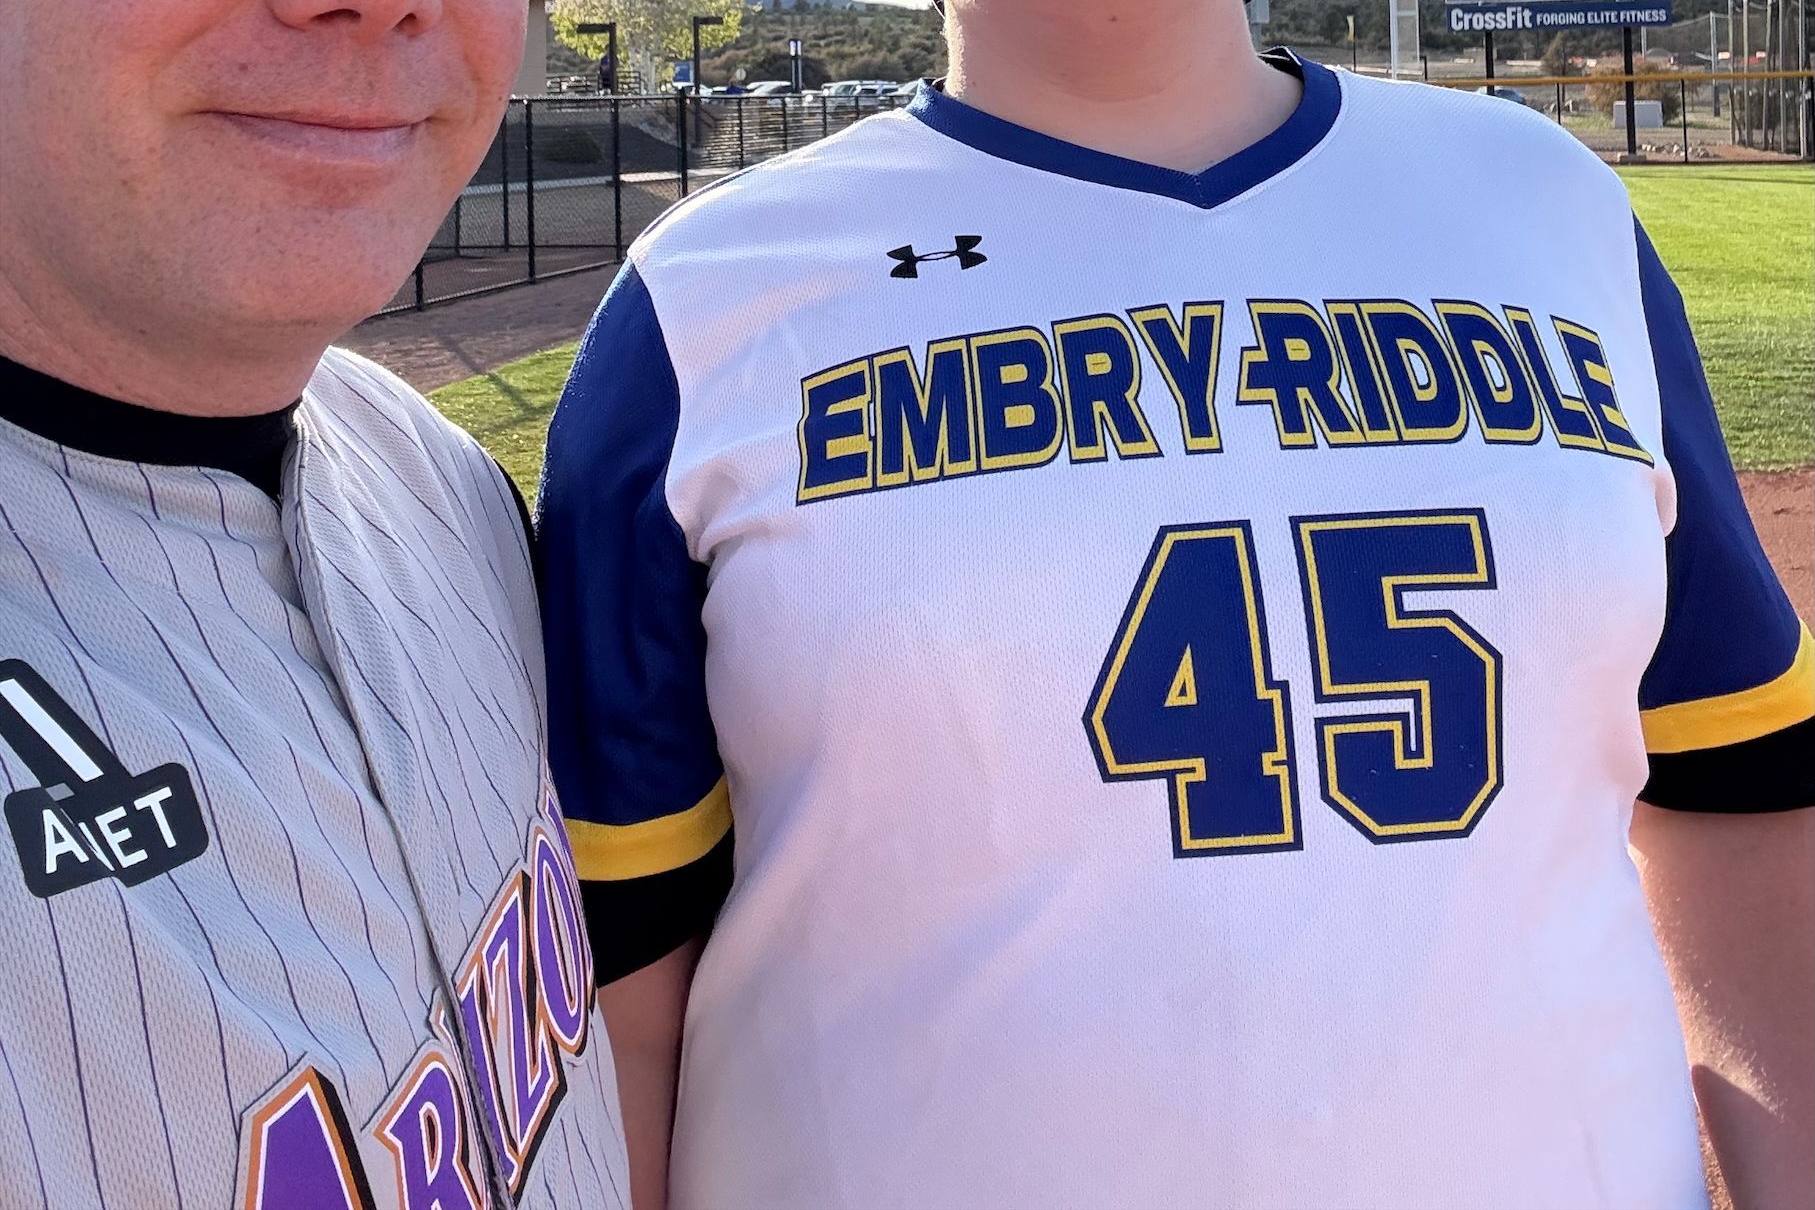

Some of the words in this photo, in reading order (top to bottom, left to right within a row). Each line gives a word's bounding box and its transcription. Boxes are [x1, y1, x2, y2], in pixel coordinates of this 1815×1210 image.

[1450, 6, 1532, 31] CrossFit
[1536, 11, 1585, 27] FORGING
[1586, 10, 1619, 24] ELITE
[1619, 8, 1667, 23] FITNESS
[1081, 507, 1504, 859] 45
